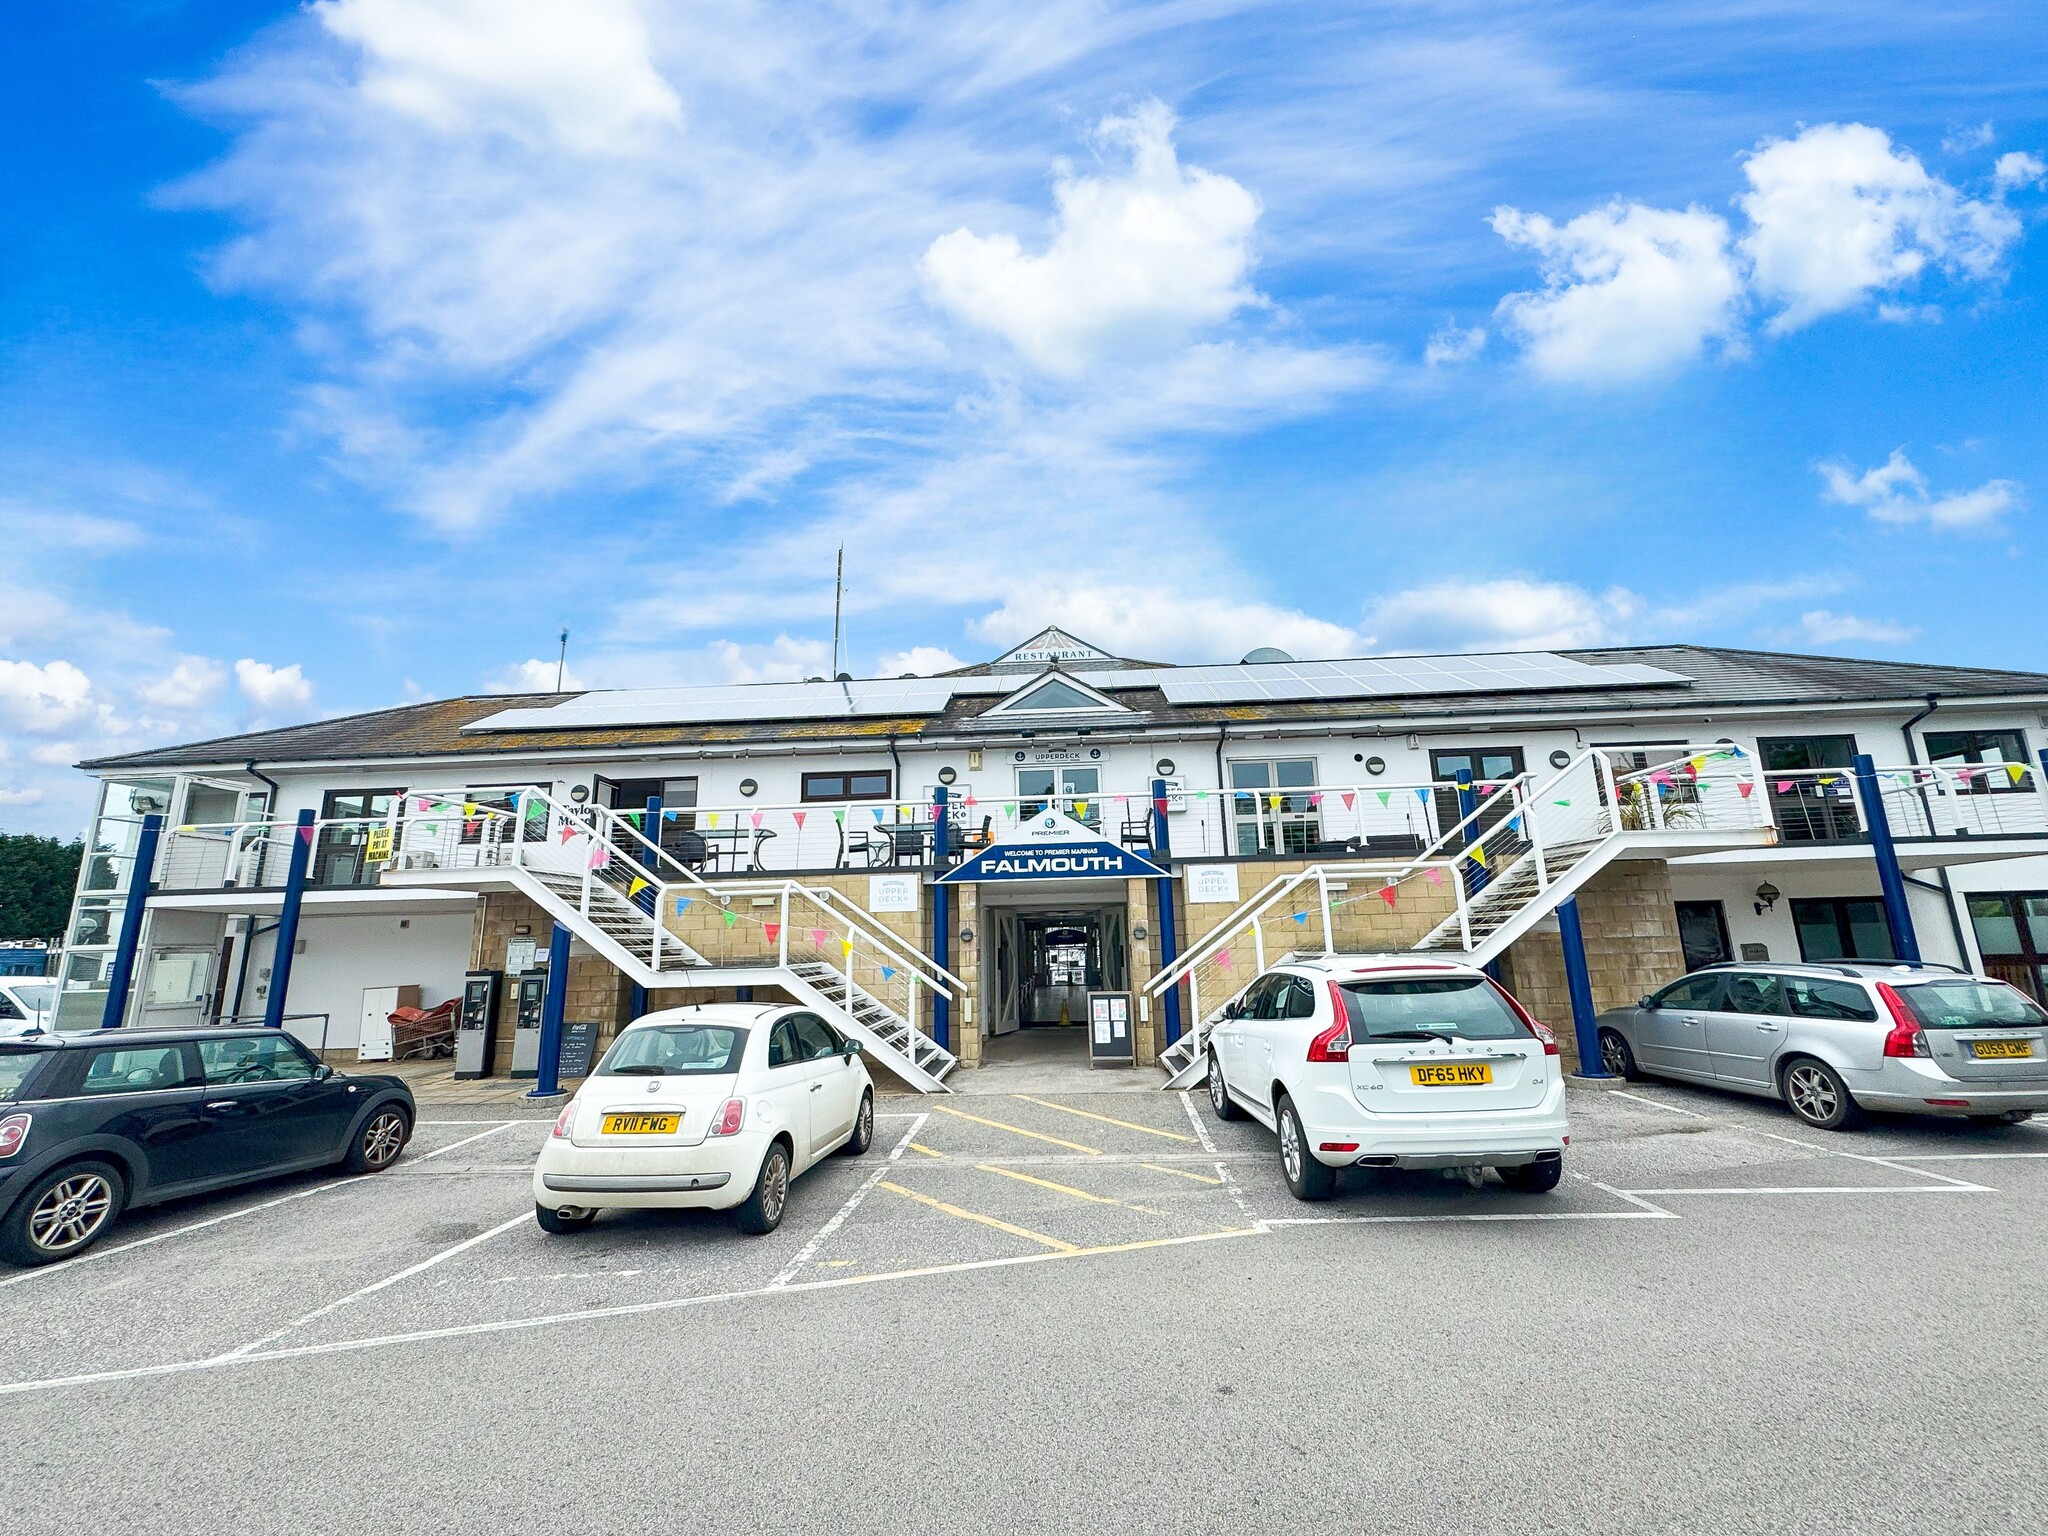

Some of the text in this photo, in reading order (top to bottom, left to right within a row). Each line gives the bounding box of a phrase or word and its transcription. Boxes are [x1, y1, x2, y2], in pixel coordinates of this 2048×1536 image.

[1015, 650, 1092, 660] RESTAURANT
[1035, 752, 1080, 760] UPPERDECK
[373, 829, 390, 839] PLEASE
[372, 839, 388, 850] PAY AT
[368, 850, 389, 860] MACHINE
[1004, 849, 1034, 857] WELCOME
[1071, 847, 1098, 855] MARINAS
[981, 856, 1123, 874] FALMOUTH
[1197, 877, 1228, 885] UPPER
[878, 887, 908, 895] UPPER
[1198, 885, 1223, 893] DECK
[1408, 1047, 1493, 1055] VOLVO
[1974, 1042, 2029, 1055] GU59 GMF
[1417, 1066, 1485, 1082] DF65 HKY
[612, 1117, 669, 1131] RV11 FWG
